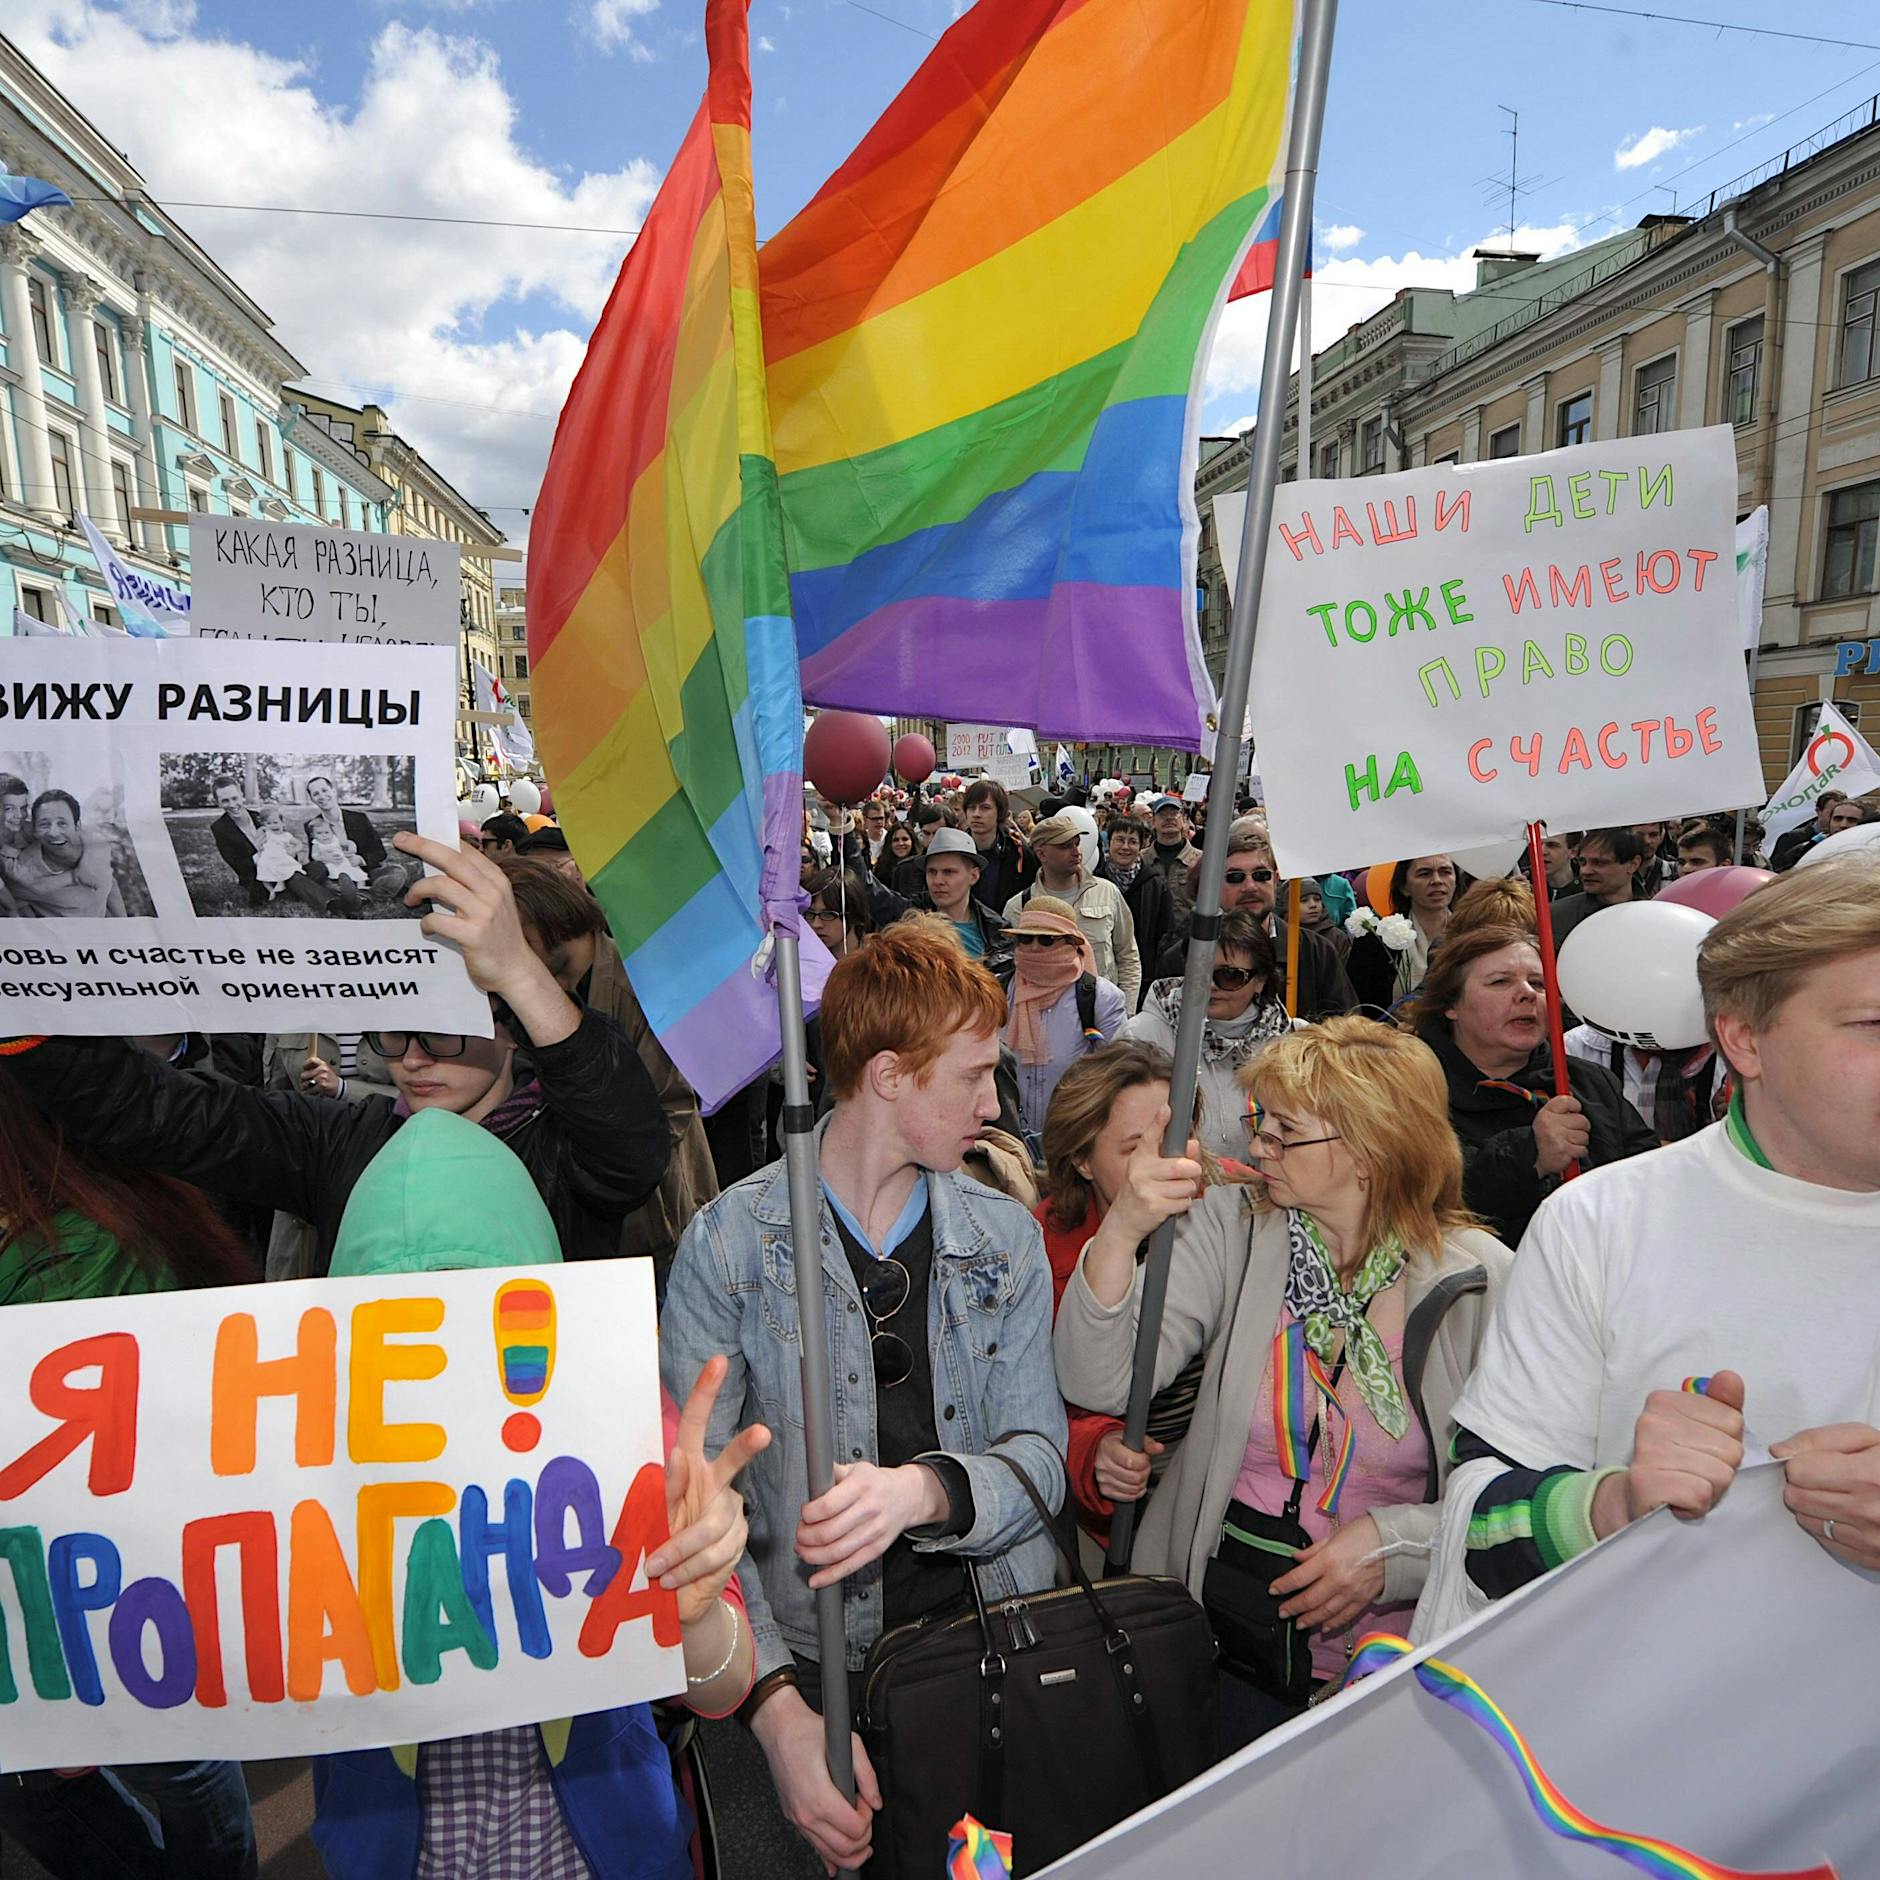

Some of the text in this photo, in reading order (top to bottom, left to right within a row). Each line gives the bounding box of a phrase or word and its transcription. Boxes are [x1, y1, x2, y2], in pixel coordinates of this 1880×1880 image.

[1279, 464, 1674, 560] НАШИ ДЕТИ
[215, 529, 438, 589] КАКАЯ РАЗНИЦА,
[261, 583, 387, 631] КТО ТЫ,
[1307, 549, 1718, 648] ТОЖЕ ИМЕЮТ
[1418, 633, 1634, 708] ПРАВО
[158, 684, 420, 728] РАЗНИЦЫ
[1345, 706, 1723, 812] НА СЧАСТЬЕ
[0, 947, 438, 966] овь и счастье не зависят
[0, 976, 419, 1003] ексуальной ориентации
[0, 1332, 139, 1500] Я
